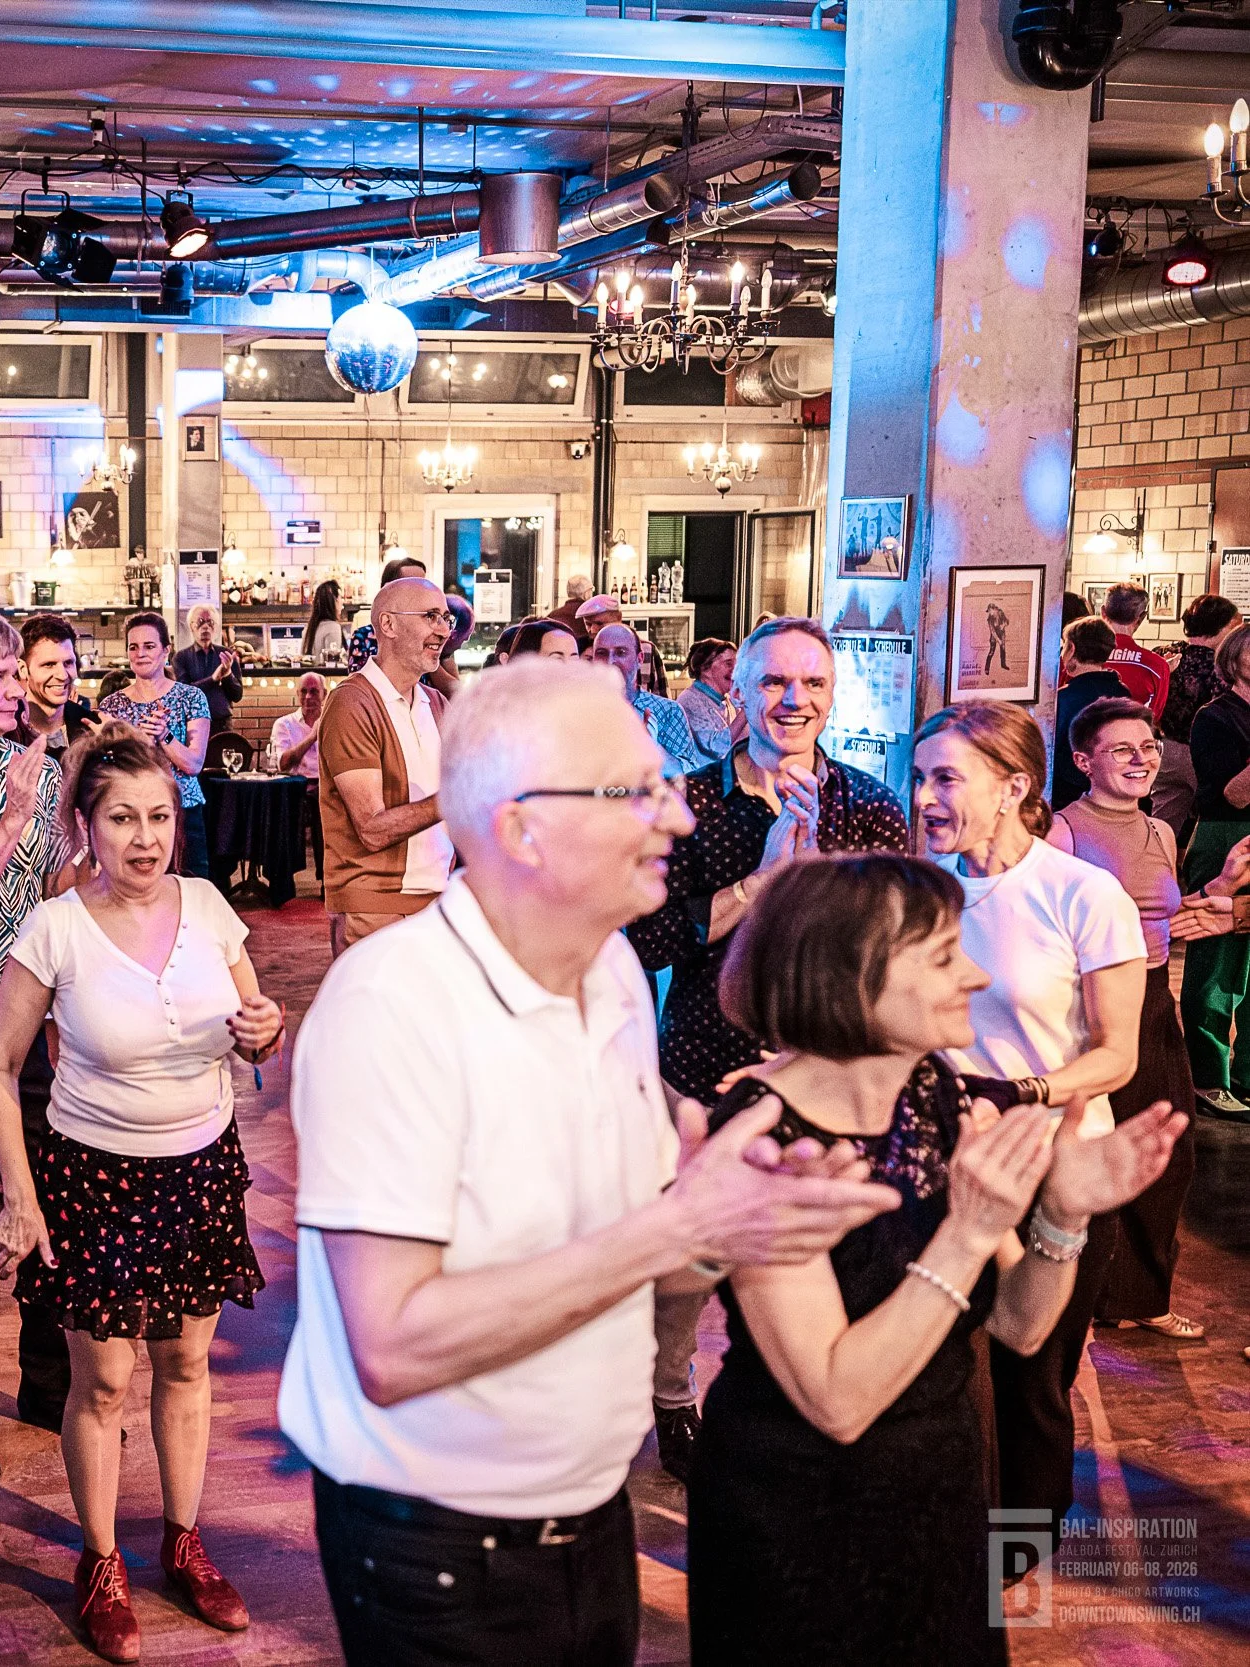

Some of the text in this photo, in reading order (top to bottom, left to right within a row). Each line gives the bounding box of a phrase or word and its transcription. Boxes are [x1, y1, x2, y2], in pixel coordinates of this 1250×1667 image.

[832, 639, 862, 652] SCHEDULE
[874, 640, 906, 654] SCHEDULE
[851, 738, 881, 754] SCHEDULE
